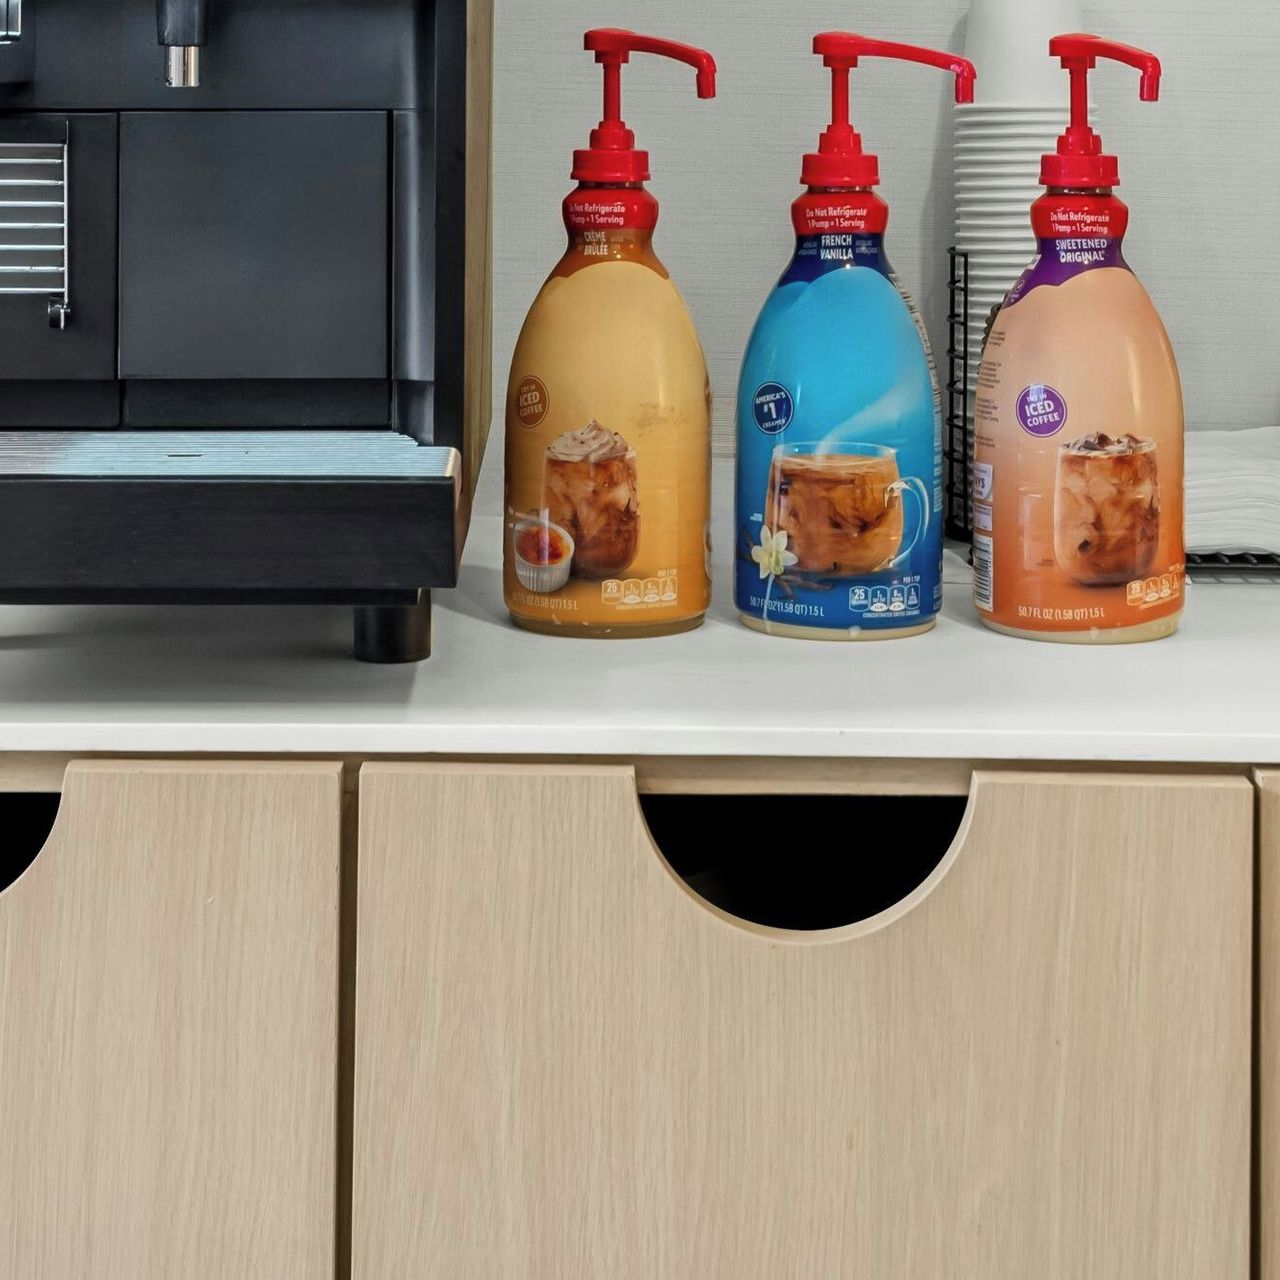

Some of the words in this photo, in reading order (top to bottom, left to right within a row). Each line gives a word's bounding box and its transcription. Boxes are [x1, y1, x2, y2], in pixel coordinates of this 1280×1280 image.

[584, 203, 625, 215] Refrigerate
[806, 208, 814, 217] Do
[815, 208, 827, 217] Not
[828, 206, 867, 218] Refrigerate
[590, 214, 594, 223] 1
[595, 214, 625, 226] Serving
[811, 219, 830, 229] Pump
[835, 218, 839, 227] 1
[840, 218, 865, 229] Serving
[1050, 211, 1057, 221] Do
[1057, 211, 1069, 221] Not
[1069, 211, 1110, 223] Refrigerate
[1055, 223, 1072, 234] Pump
[1076, 222, 1080, 232] 1
[1081, 223, 1108, 235] Serving
[821, 234, 853, 247] FRENCH
[1056, 238, 1108, 250] SWEETENED
[820, 247, 854, 260] VANILLA
[1060, 250, 1105, 263] ORIGINAL
[520, 391, 540, 407] ICED
[756, 391, 786, 405] AMERICA'S
[1024, 400, 1055, 417] ICED
[1027, 411, 1060, 427] COFFEE
[854, 588, 865, 600] 25
[768, 600, 777, 611] OZ
[777, 601, 794, 613] (1.58
[794, 603, 808, 616] QT)
[809, 605, 819, 616] 1.5
[820, 606, 825, 617] L
[1017, 606, 1032, 617] 50.7
[1033, 607, 1042, 619] FL
[1043, 608, 1054, 619] OZ
[1054, 608, 1073, 621] (1.58
[1074, 608, 1089, 620] QT)
[1089, 607, 1100, 618] 1.5
[1100, 607, 1106, 617] L
